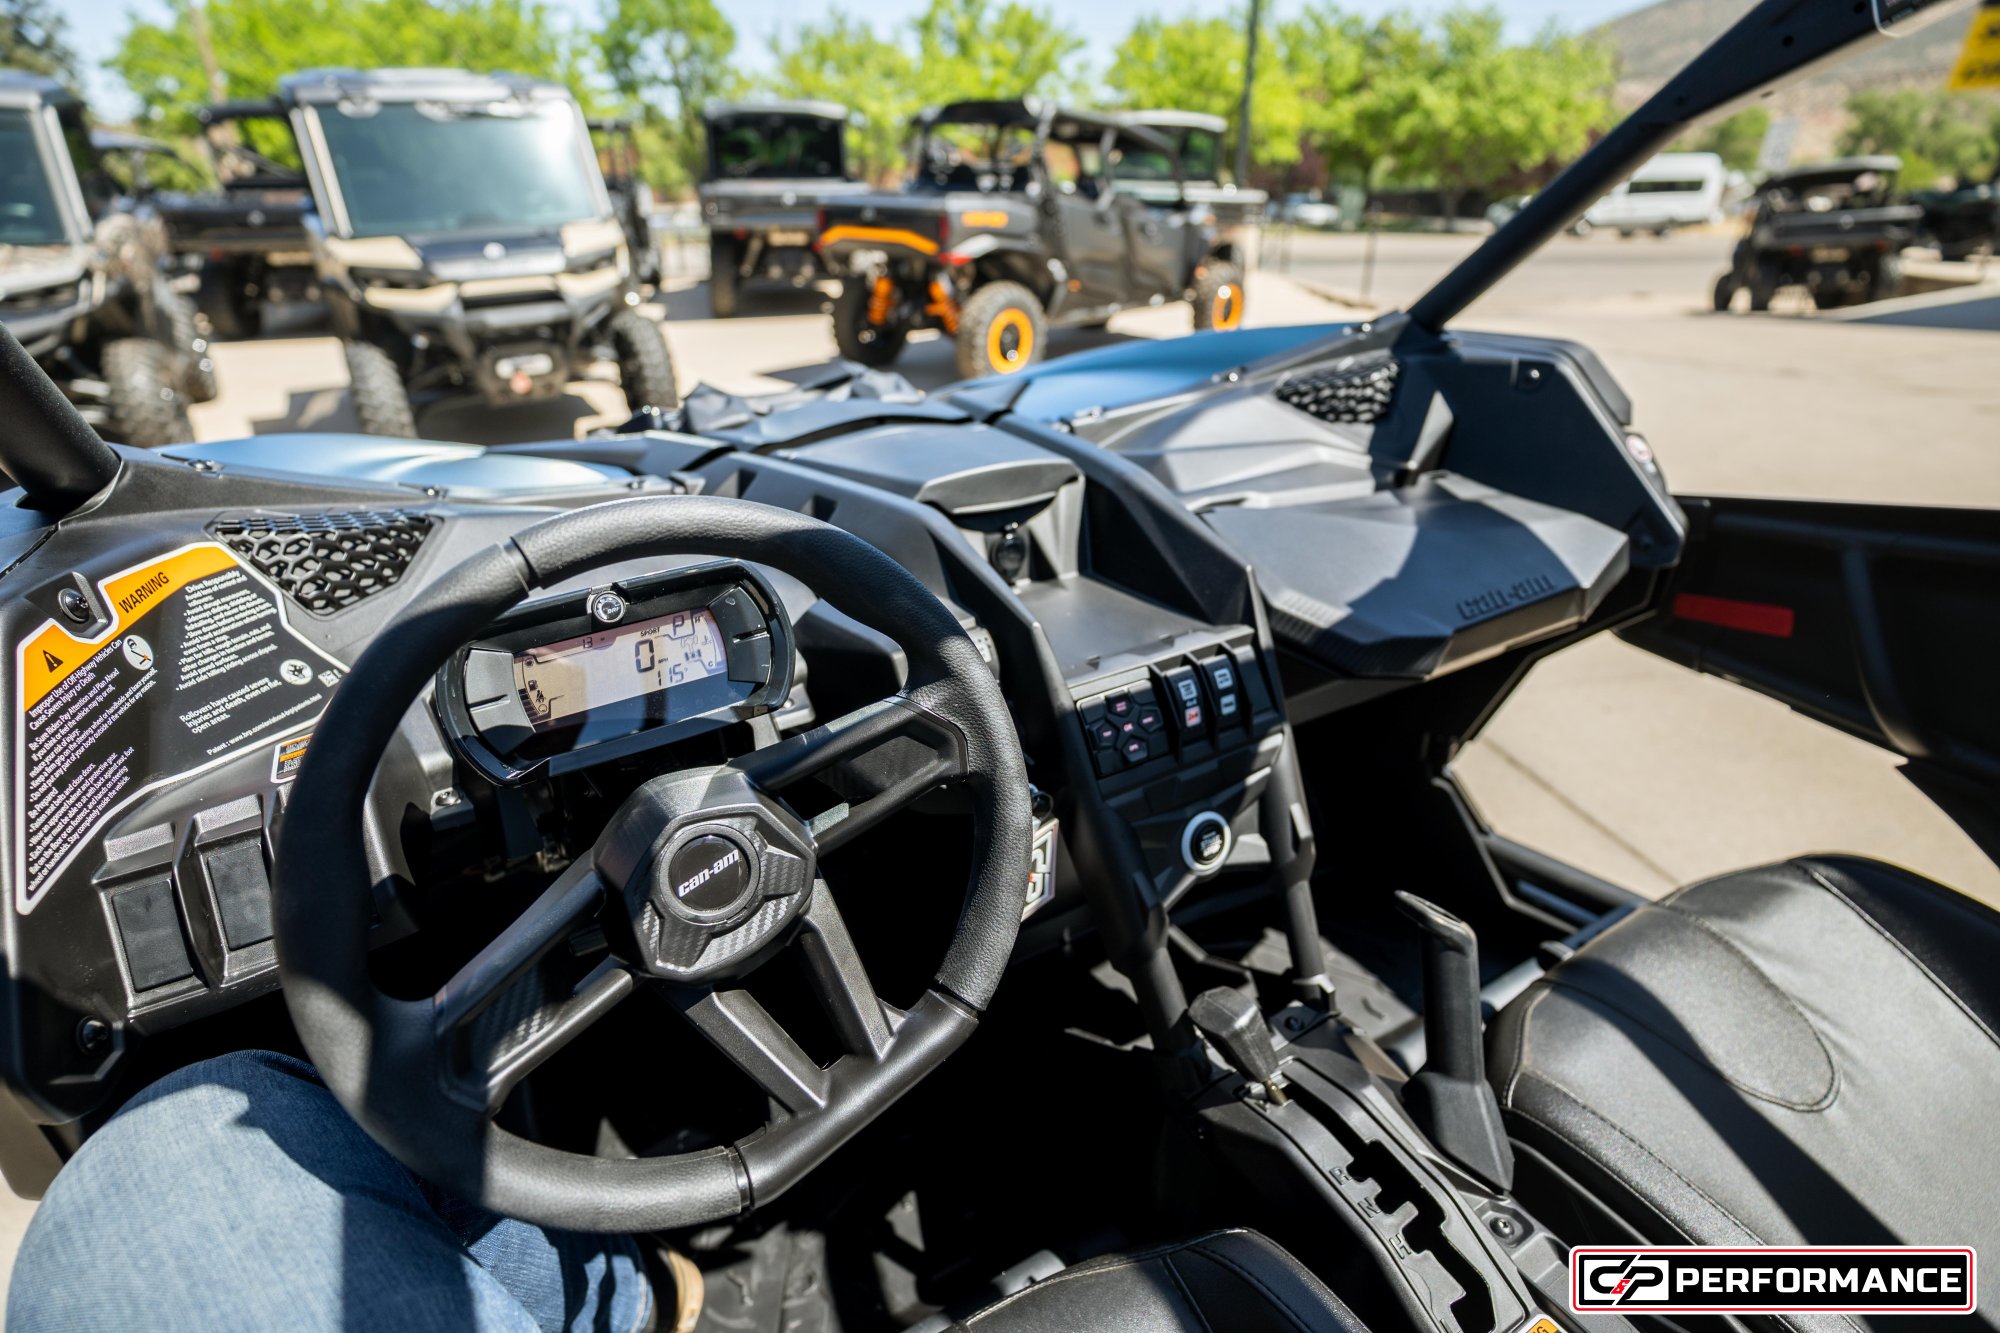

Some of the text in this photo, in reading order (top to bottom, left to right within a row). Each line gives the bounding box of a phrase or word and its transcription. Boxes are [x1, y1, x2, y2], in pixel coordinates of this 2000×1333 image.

[119, 572, 170, 613] WARNING
[1456, 575, 1553, 620] can-am
[640, 627, 660, 637] SPORT
[672, 615, 684, 636] P
[635, 639, 654, 673] 0
[28, 639, 122, 718] Improper Use of Off-Highway Vehicles Can
[28, 667, 119, 751] Be Sure Riders Pay Attention and Plan Ahead
[29, 712, 48, 730] Cause
[44, 700, 64, 717] Severe
[59, 688, 77, 703] Injury
[79, 672, 96, 687] Death
[179, 677, 270, 722] Rollovers have caused severe
[185, 712, 213, 728] injuries
[211, 704, 226, 716] and
[224, 694, 247, 710] death,
[245, 688, 262, 700] even
[192, 713, 230, 734] open areas.
[27, 786, 59, 819] Be Prepared
[678, 849, 739, 897] can-am
[1389, 1234, 1411, 1260] H
